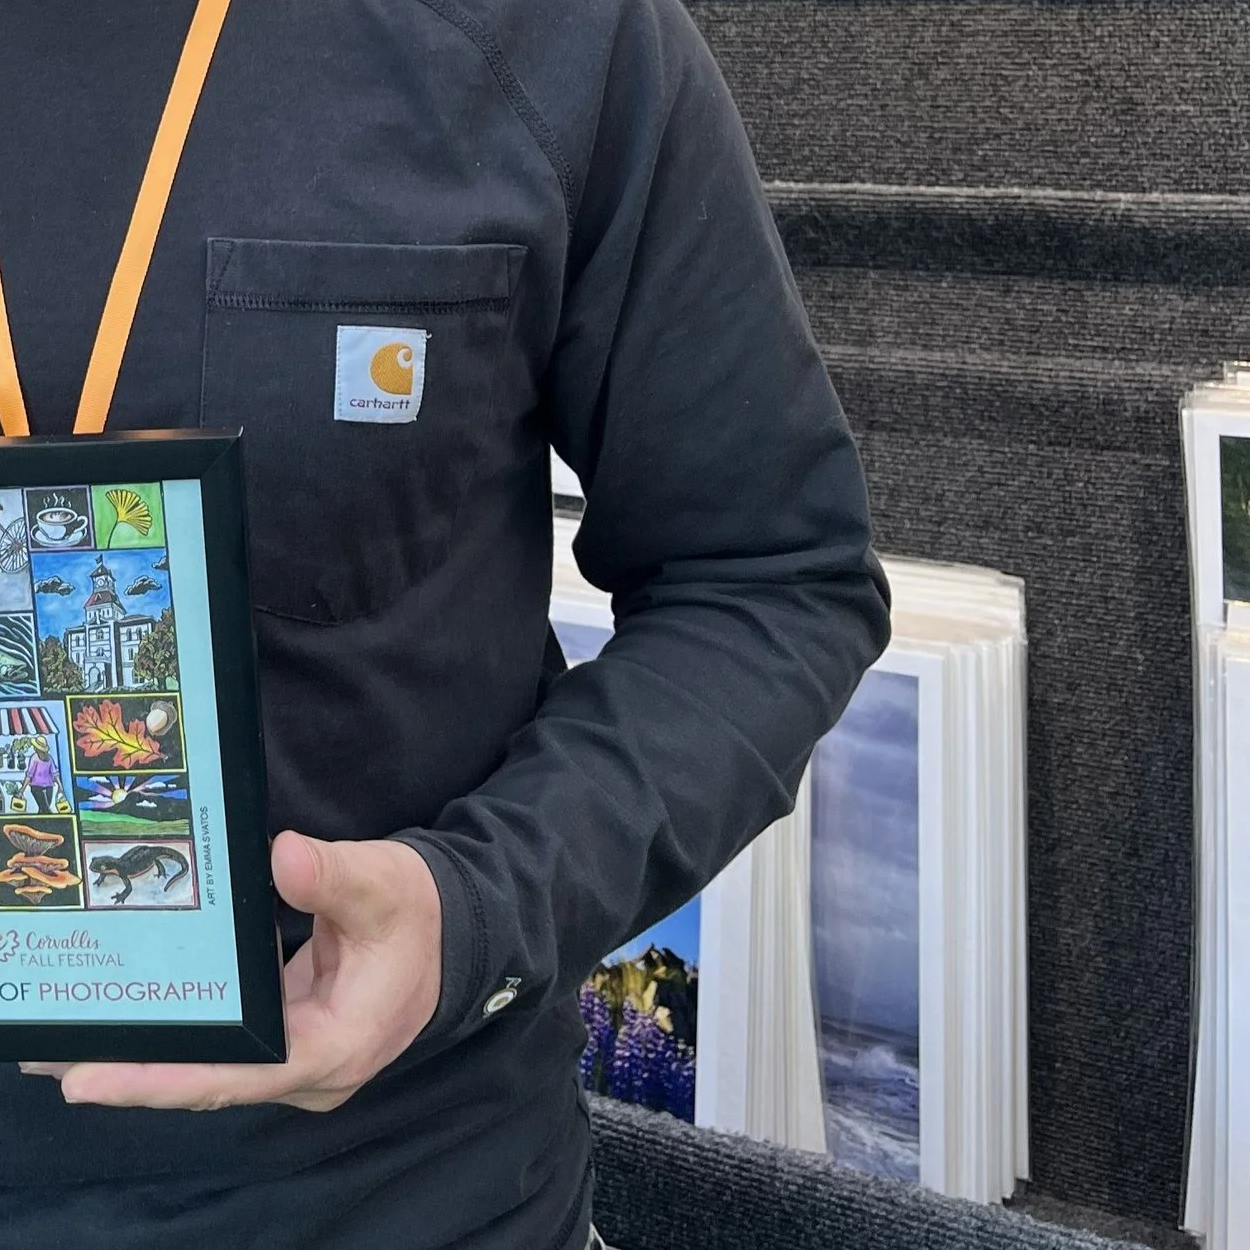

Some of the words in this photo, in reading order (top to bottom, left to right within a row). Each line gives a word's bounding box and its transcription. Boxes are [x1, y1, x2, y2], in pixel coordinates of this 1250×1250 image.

[350, 398, 411, 410] carhartt
[200, 806, 210, 843] SVATOS
[206, 873, 215, 886] BY
[205, 889, 215, 906] ART
[25, 930, 101, 951] Corvallis
[19, 953, 55, 967] FALL
[58, 953, 125, 967] FESTIVAL
[38, 981, 228, 1001] PHOTOGRAPHY
